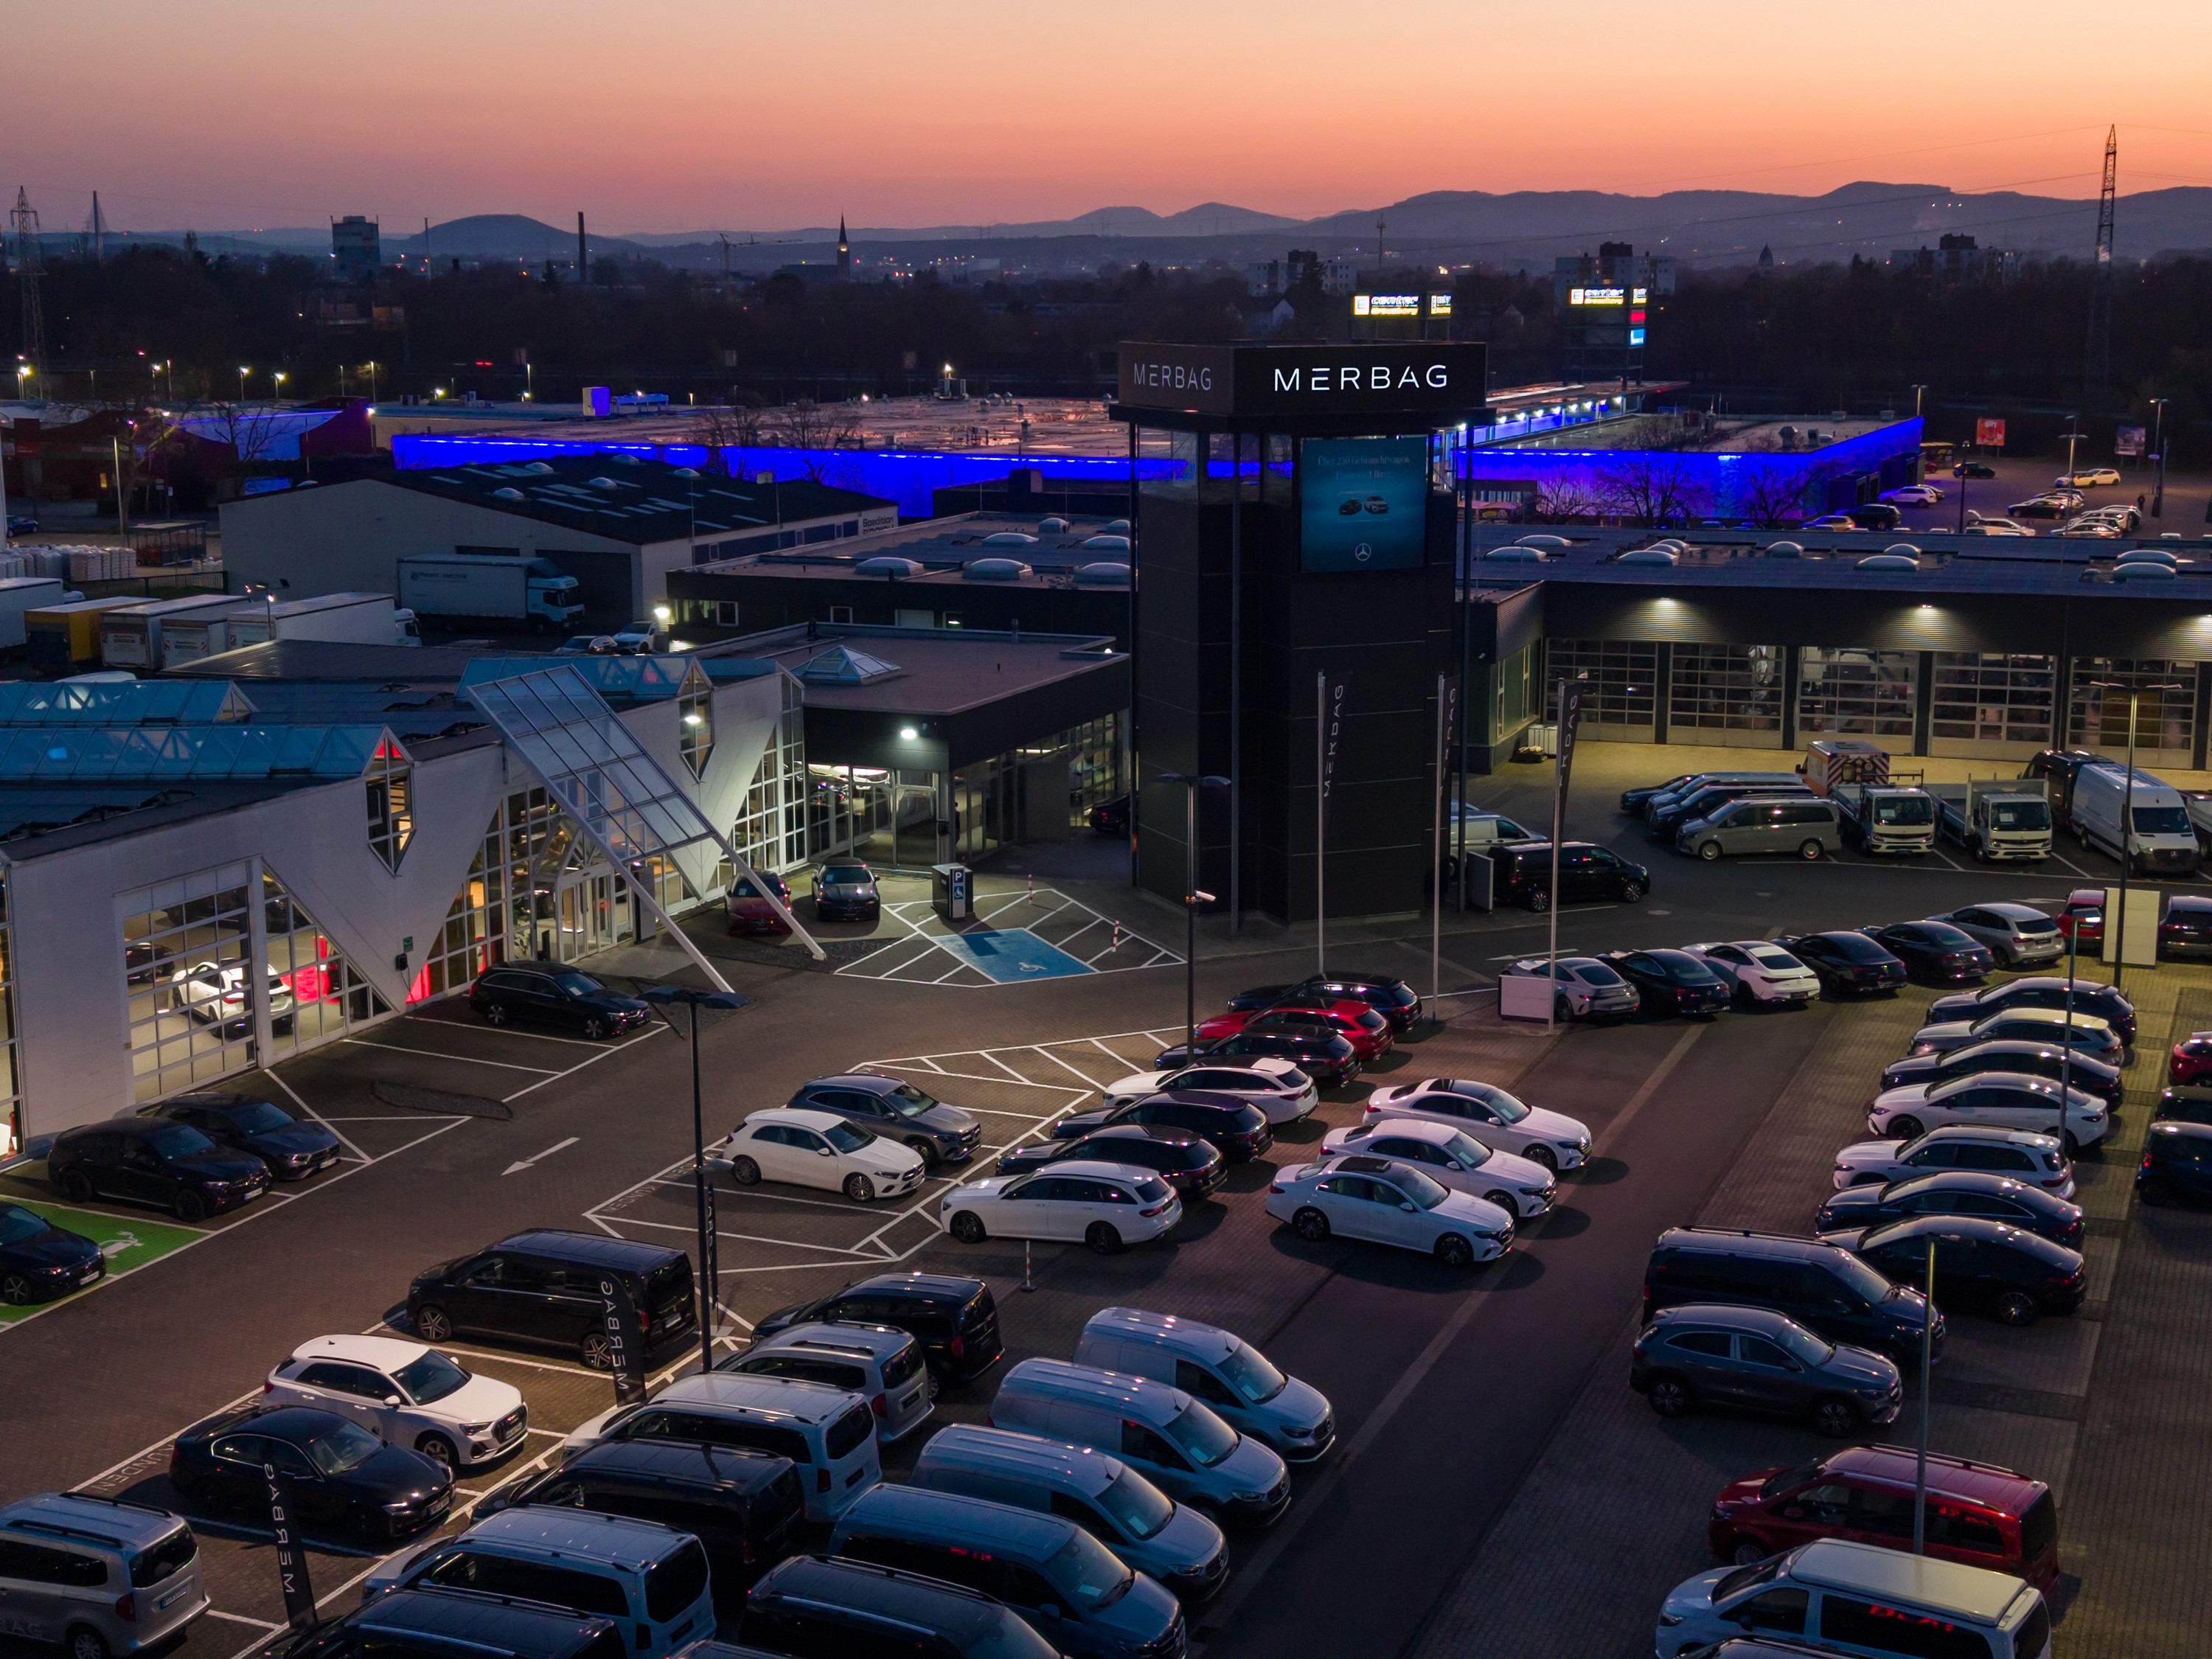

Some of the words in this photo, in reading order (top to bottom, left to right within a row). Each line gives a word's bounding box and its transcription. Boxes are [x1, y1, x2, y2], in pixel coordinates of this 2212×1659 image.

[1134, 363, 1211, 391] MERBAG
[1274, 364, 1448, 392] MERBAG
[862, 515, 894, 527] Spedition
[955, 872, 962, 882] P
